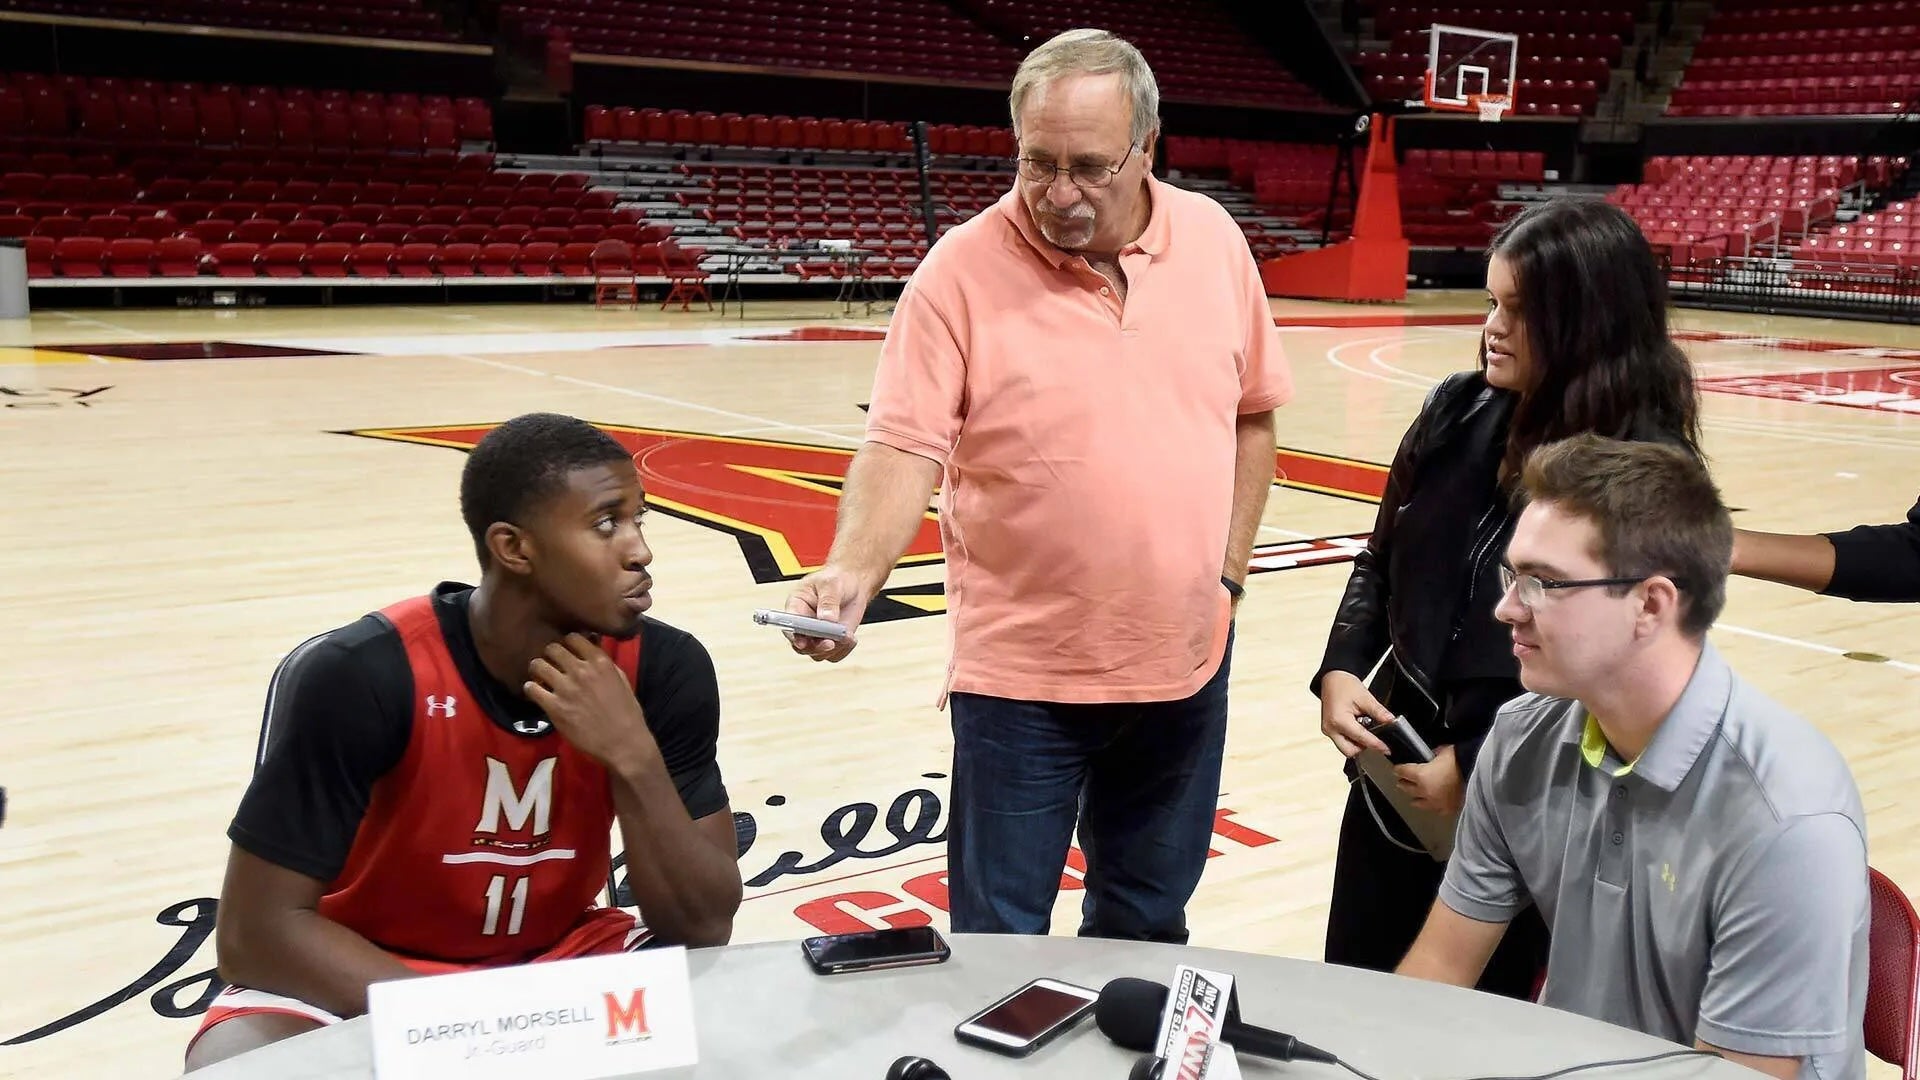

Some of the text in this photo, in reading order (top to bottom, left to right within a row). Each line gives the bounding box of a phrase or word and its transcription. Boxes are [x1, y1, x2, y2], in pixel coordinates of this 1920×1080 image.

[473, 754, 557, 836] M
[481, 874, 530, 936] 11
[1175, 970, 1192, 1012] RADIO
[1195, 979, 1207, 997] THE
[1201, 984, 1219, 1013] FAN
[407, 1006, 595, 1045] DARRYL MORSELL
[603, 987, 651, 1039] M
